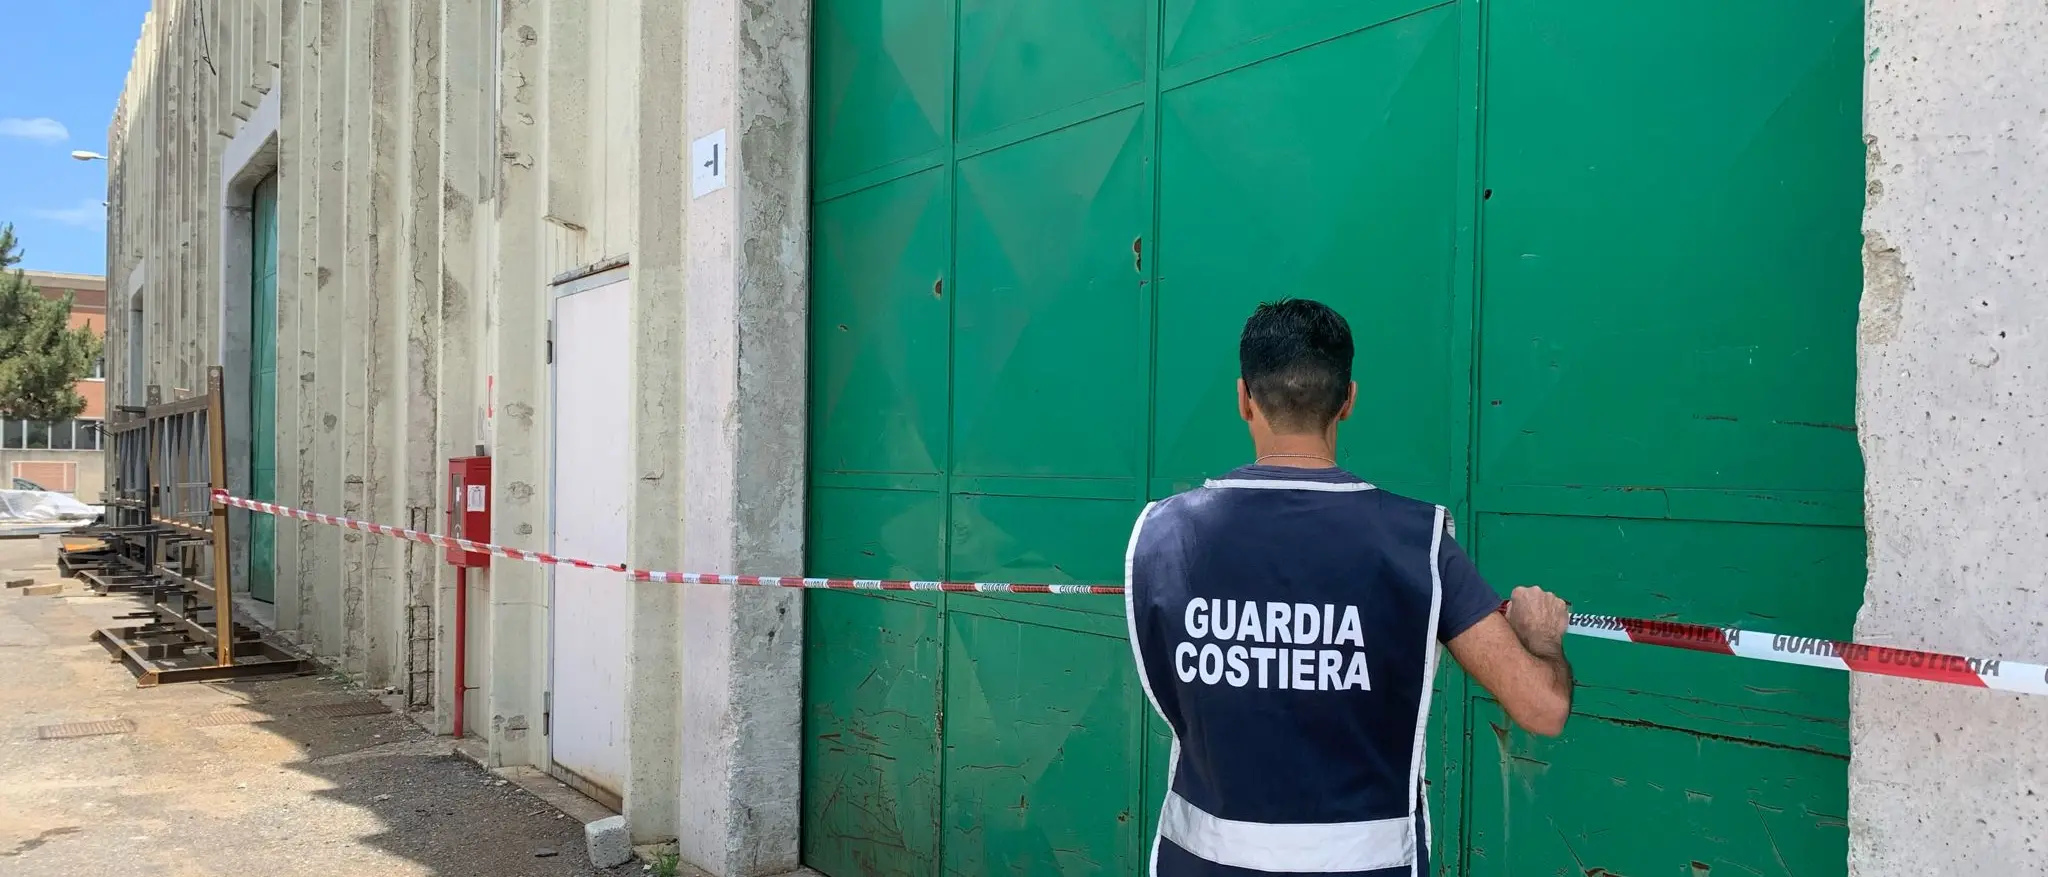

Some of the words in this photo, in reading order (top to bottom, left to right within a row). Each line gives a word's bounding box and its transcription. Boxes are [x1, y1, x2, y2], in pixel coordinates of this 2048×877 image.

[1184, 597, 1364, 647] GUARDIA
[1175, 642, 1371, 691] COSTIERA
[1773, 633, 1869, 661] GUARDIA
